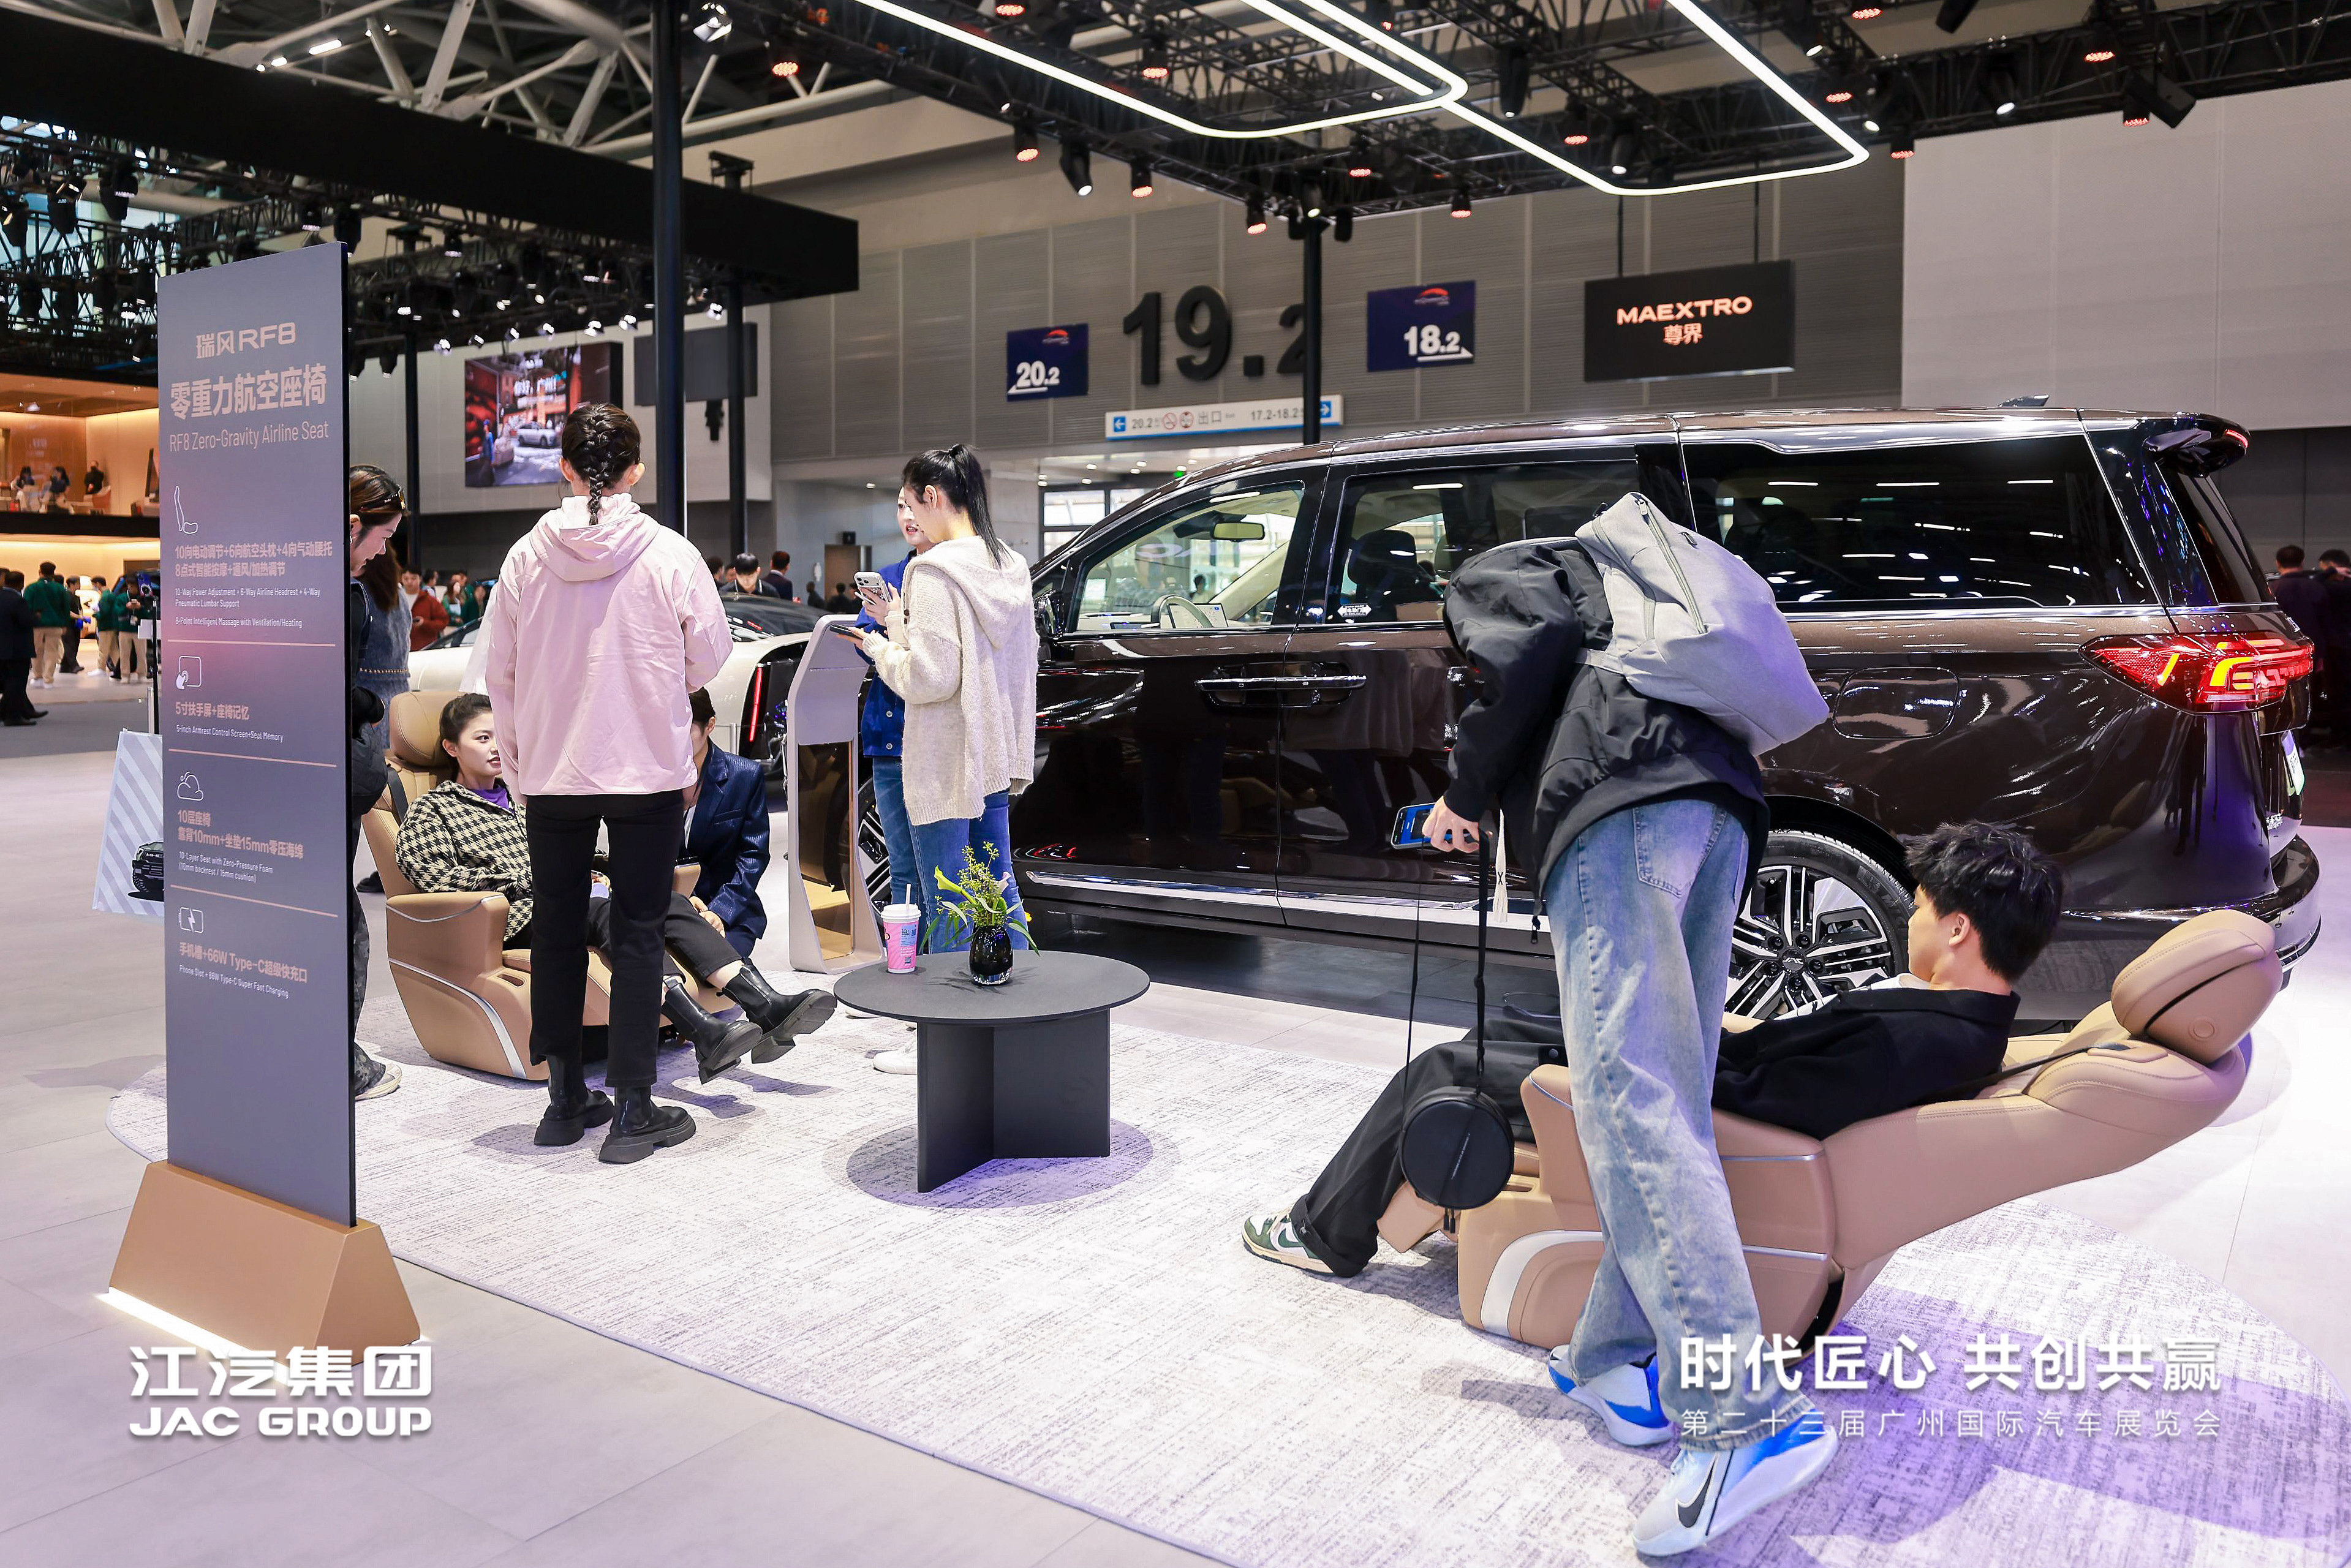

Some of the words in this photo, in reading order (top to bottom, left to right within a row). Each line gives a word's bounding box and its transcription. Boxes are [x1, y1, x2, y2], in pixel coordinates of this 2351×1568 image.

[1616, 296, 1753, 326] MAEXTRO
[1123, 285, 1304, 385] 19.2
[1404, 325, 1460, 356] 18.2
[1663, 323, 1702, 345] 尊界
[1016, 360, 1060, 387] 20.2
[170, 363, 326, 420] 零重力航空座椅
[1198, 412, 1222, 425] 出口
[170, 432, 189, 451] RF8
[192, 428, 258, 449] Zero-Gravity
[262, 424, 298, 443] Airline
[301, 421, 328, 440] Seat
[208, 588, 235, 597] Adjustment
[240, 588, 256, 598] 6-Way
[257, 587, 273, 596] Airline
[274, 587, 298, 596] Headrest
[304, 588, 320, 598] 4-Way
[220, 600, 240, 609] Support
[193, 617, 217, 627] Intelligent
[218, 618, 240, 627] Massage
[175, 701, 250, 720] 5寸扶手屏+座椅记忆
[192, 726, 211, 735] Armrest
[212, 728, 230, 736] Control
[263, 732, 284, 742] Memory
[178, 810, 211, 827] 10层座椅
[199, 854, 211, 864] Seat
[223, 857, 259, 870] Zero-Pressure
[259, 864, 273, 873] Foam
